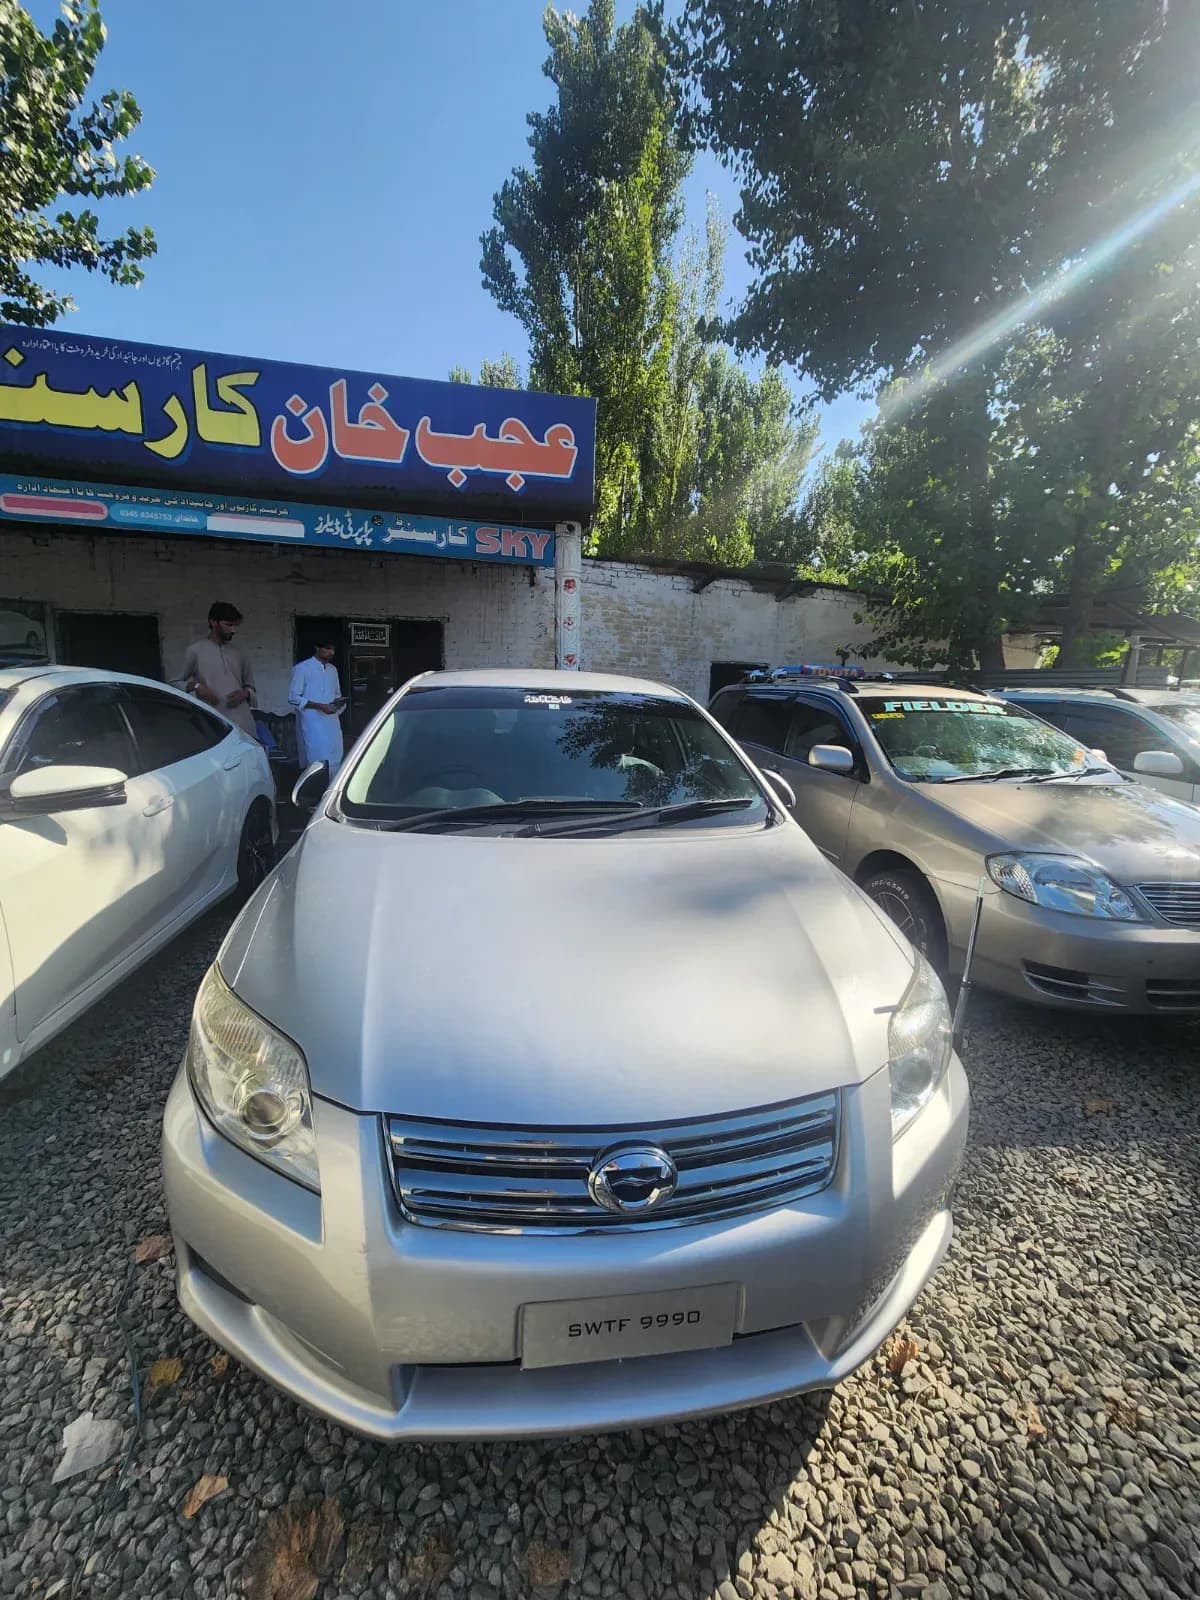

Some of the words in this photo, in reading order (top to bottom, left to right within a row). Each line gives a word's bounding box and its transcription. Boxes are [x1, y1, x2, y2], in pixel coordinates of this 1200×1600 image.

[143, 362, 261, 459] کار
[270, 378, 411, 475] خان
[415, 415, 578, 492] عجب
[382, 517, 438, 544] سنٹر
[436, 523, 469, 549] کار
[475, 526, 551, 560] SKY
[811, 667, 858, 677] TOYOTA
[883, 700, 1008, 716] FIELDER
[568, 1318, 631, 1337] SWTF
[640, 1310, 701, 1330] 9990
